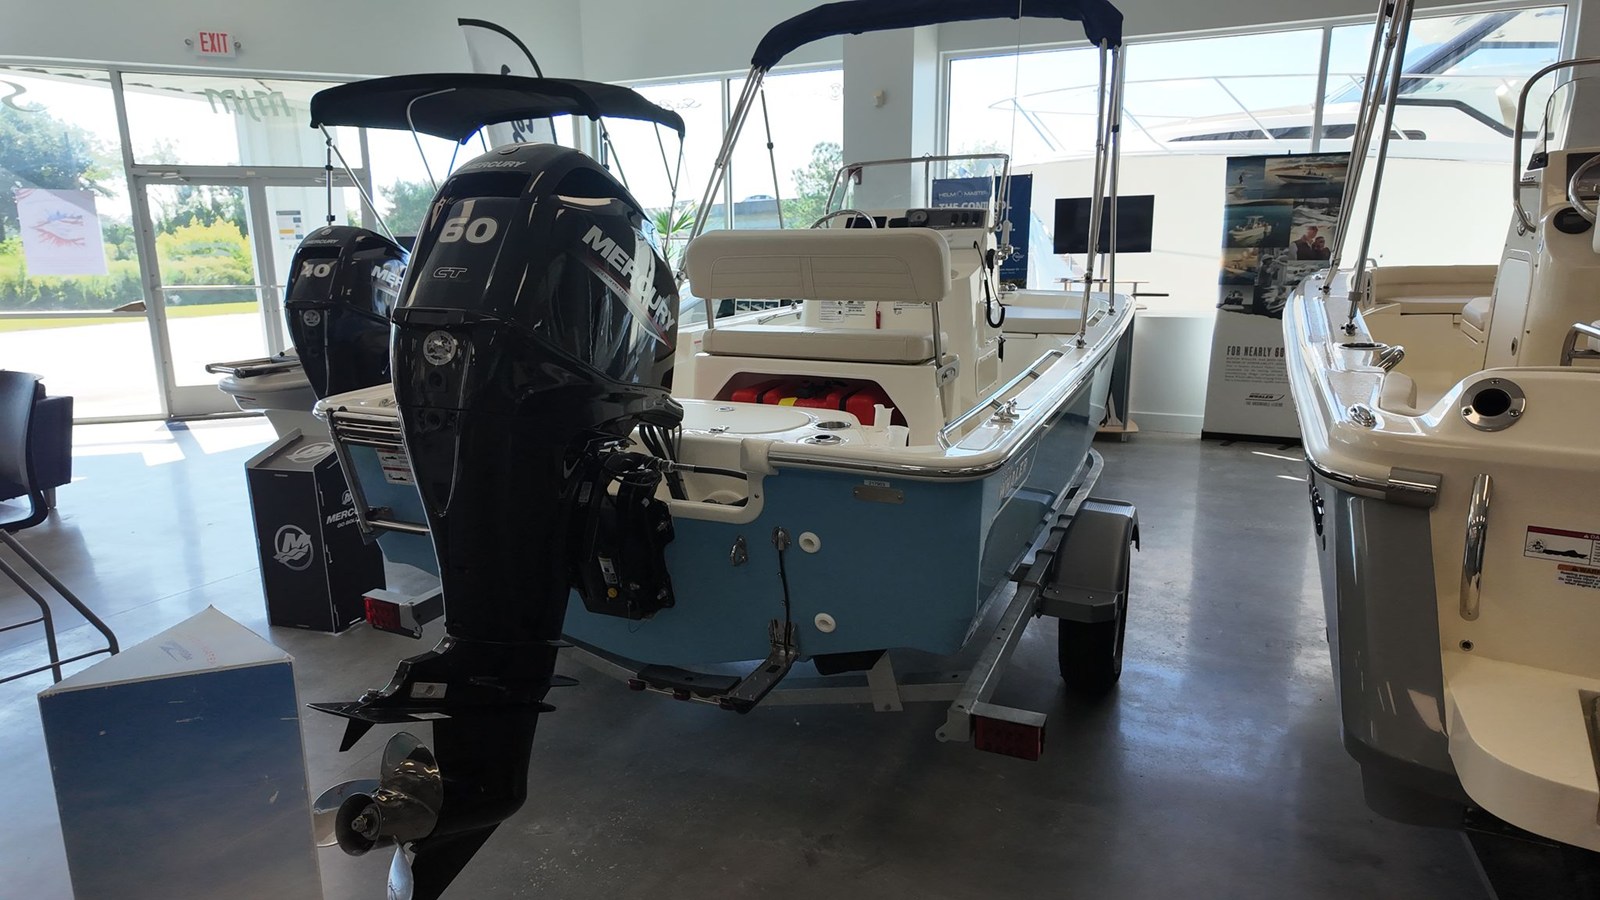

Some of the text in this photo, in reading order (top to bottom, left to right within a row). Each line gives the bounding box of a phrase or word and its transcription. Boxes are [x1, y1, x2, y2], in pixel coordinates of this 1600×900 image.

[200, 32, 228, 53] EXIT
[440, 217, 498, 244] 60
[301, 262, 331, 278] 40
[433, 266, 468, 279] CT
[1226, 345, 1241, 356] FOR
[1244, 346, 1272, 357] NEARLY
